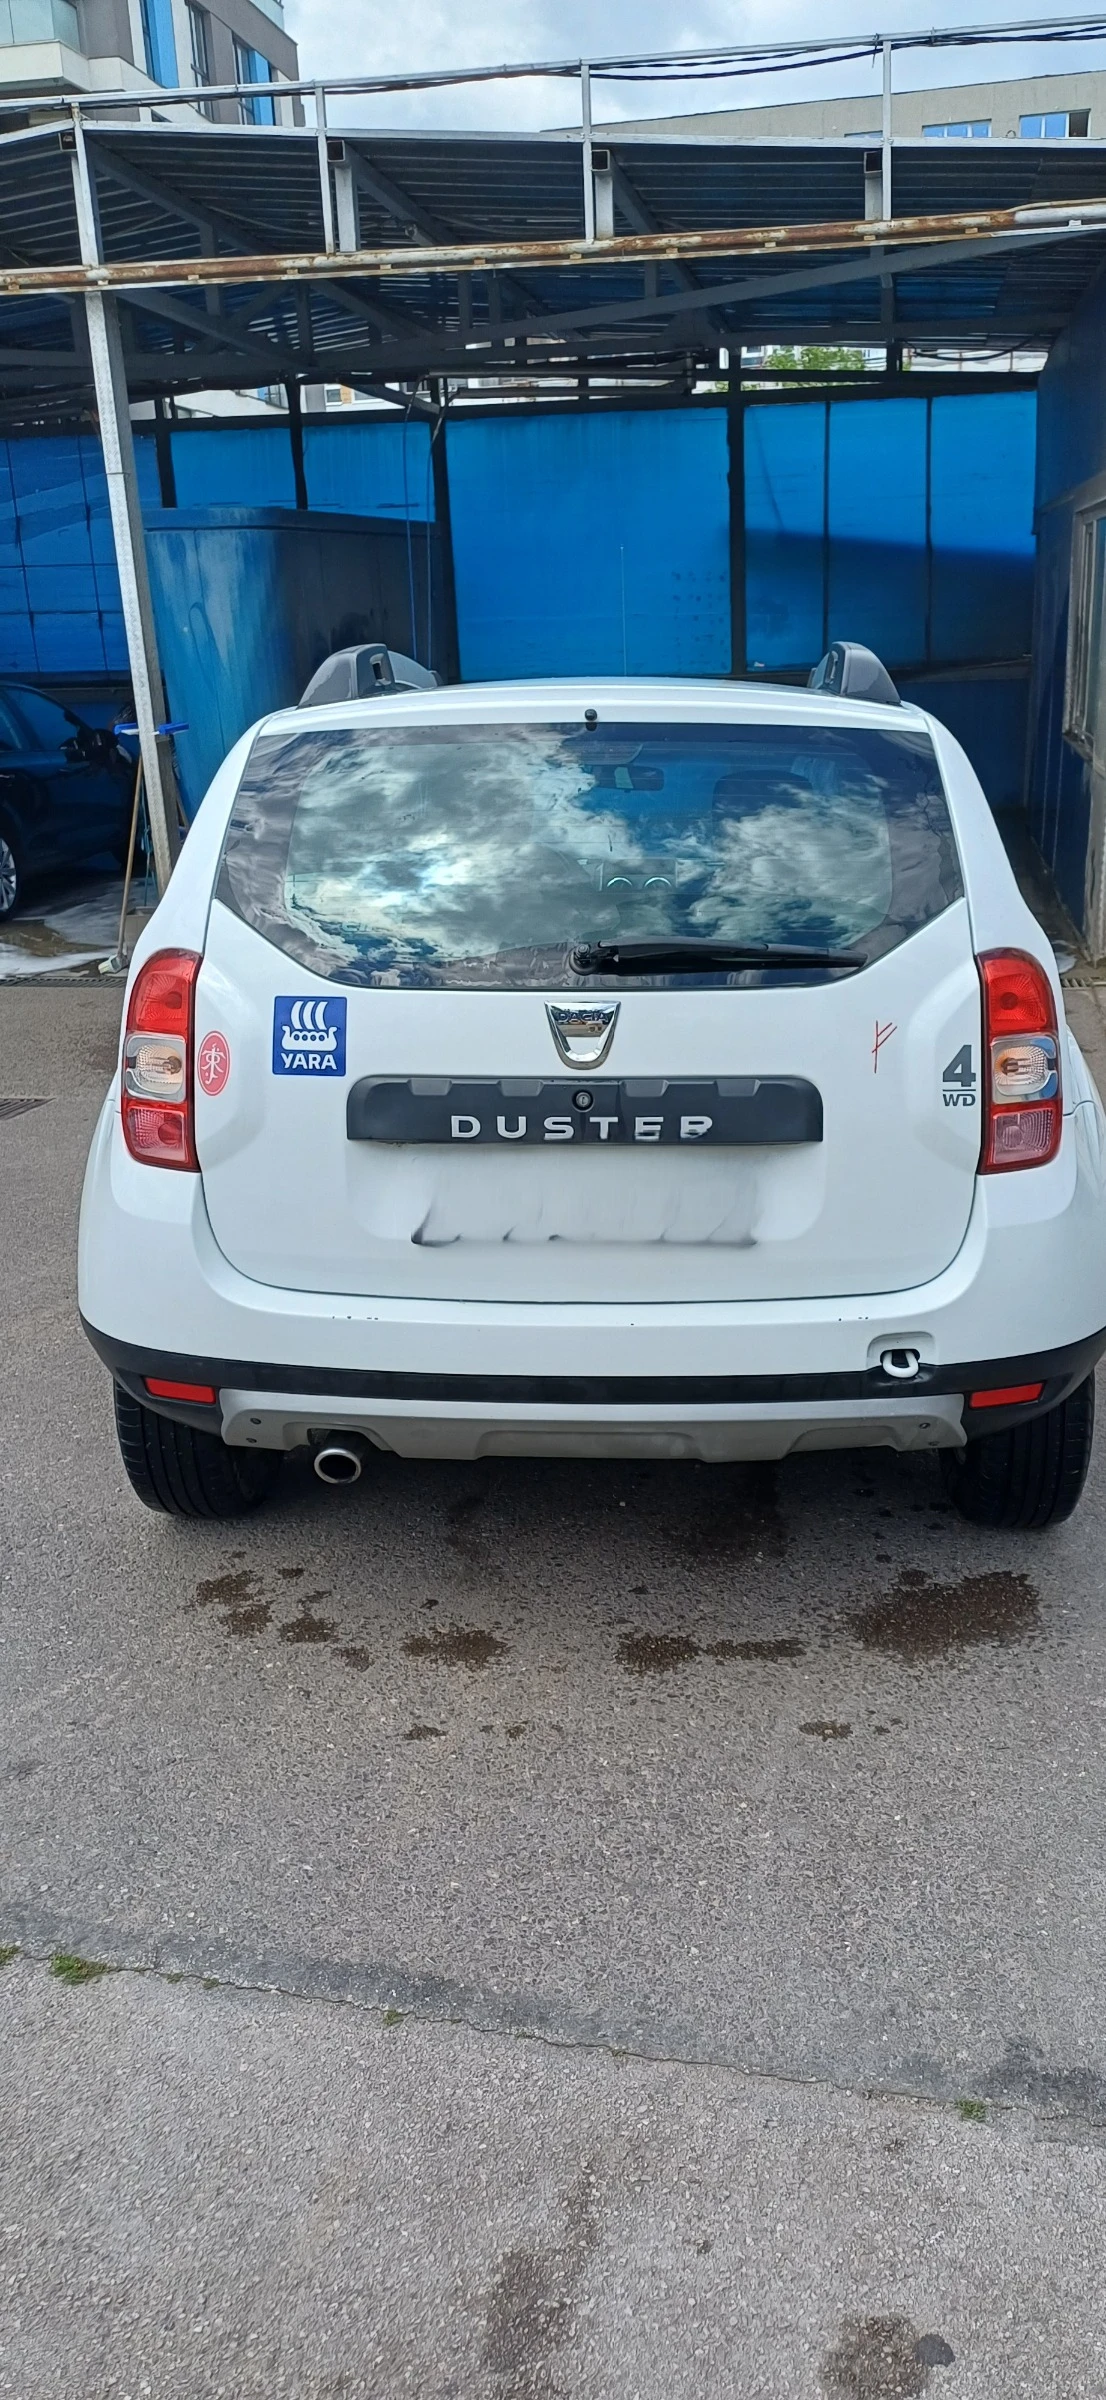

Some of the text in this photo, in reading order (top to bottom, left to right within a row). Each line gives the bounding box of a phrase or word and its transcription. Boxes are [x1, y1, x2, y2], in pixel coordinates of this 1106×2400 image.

[280, 1052, 337, 1070] YARA
[942, 1044, 976, 1087] 4
[942, 1093, 976, 1107] WD
[451, 1115, 713, 1140] DUSTER
